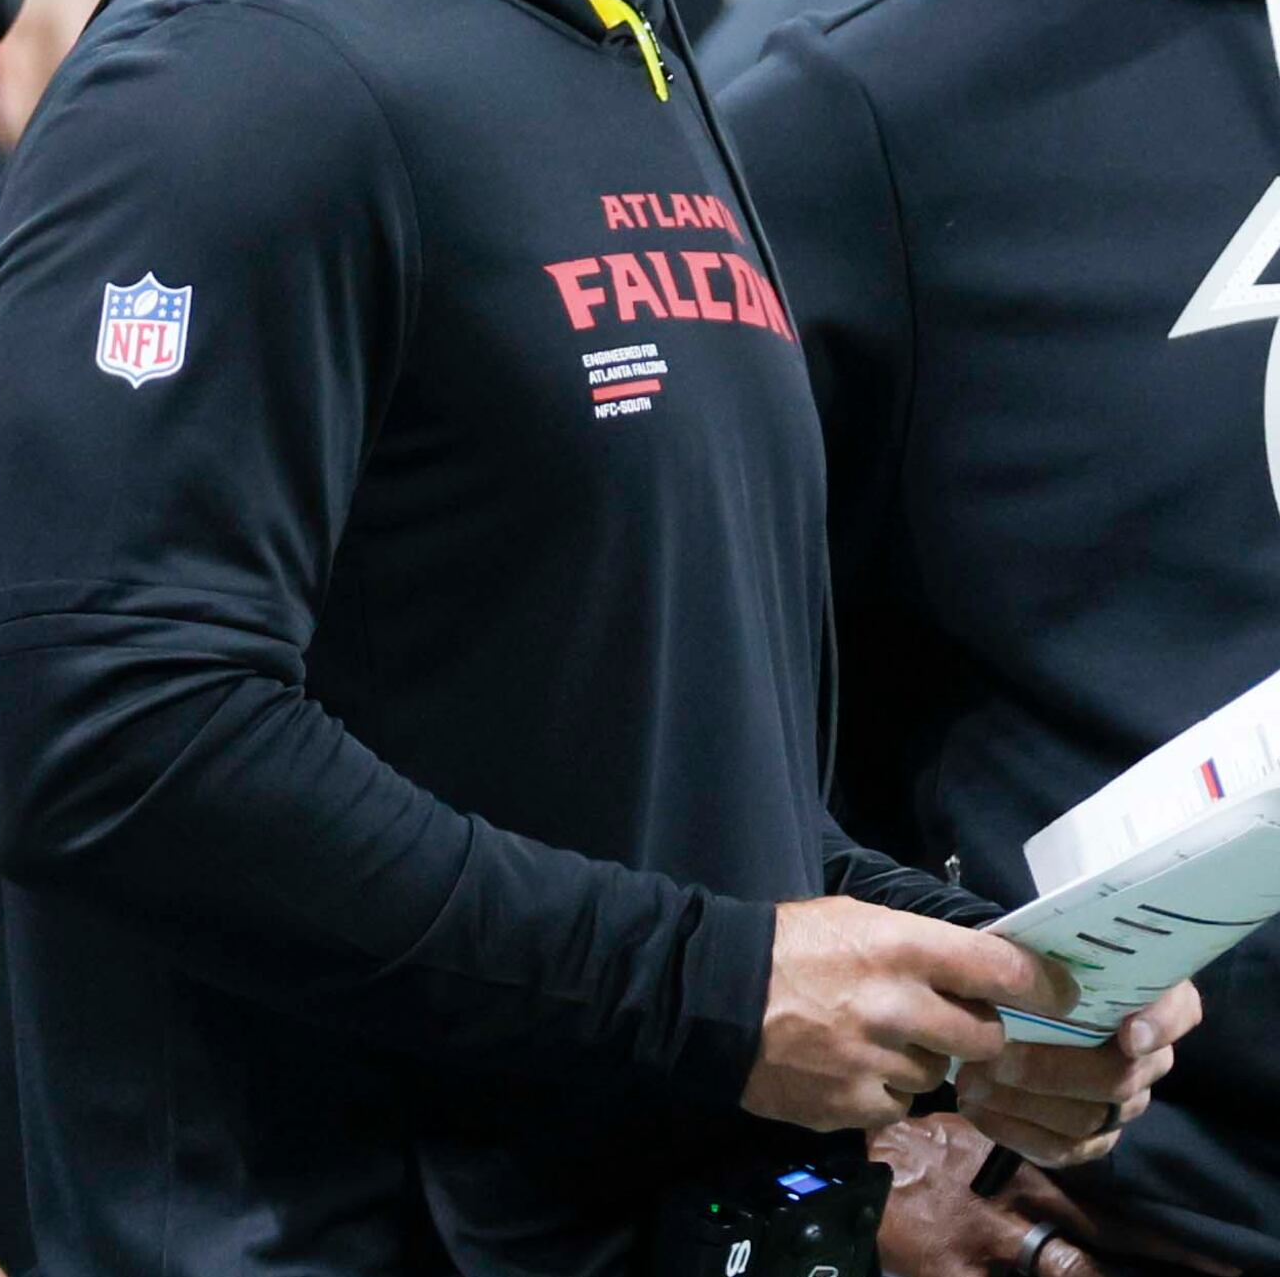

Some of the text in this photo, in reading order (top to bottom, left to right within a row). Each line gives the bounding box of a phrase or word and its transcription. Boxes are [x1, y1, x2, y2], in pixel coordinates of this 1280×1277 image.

[108, 323, 173, 369] NFL
[582, 344, 658, 367] ENGINEERED FOR
[589, 360, 668, 384] ATLANTA FALCONS
[594, 397, 651, 418] NFC-SOUTH
